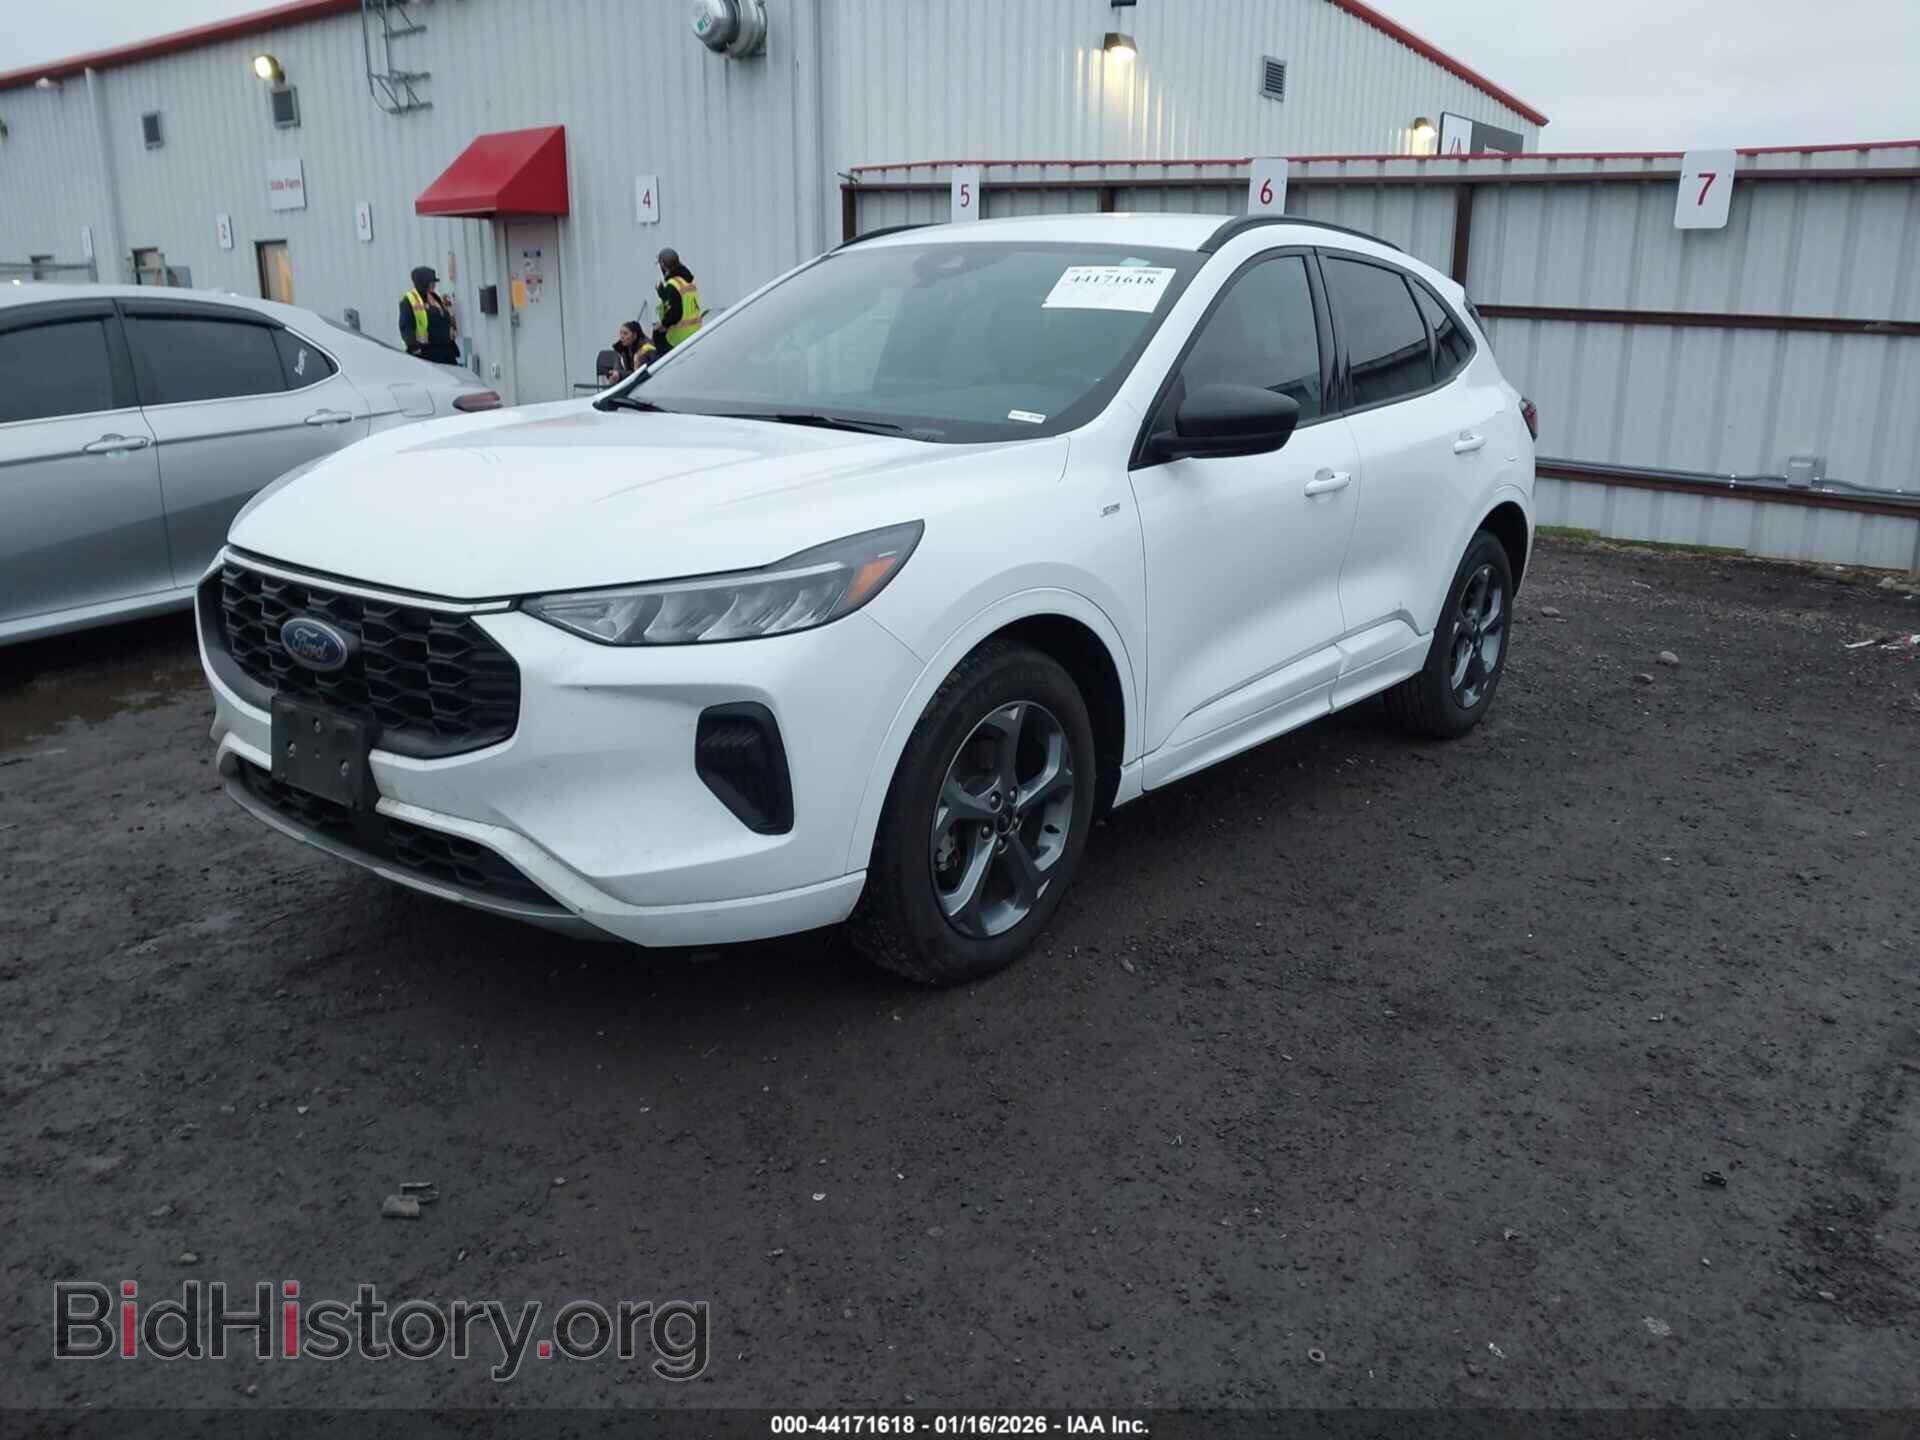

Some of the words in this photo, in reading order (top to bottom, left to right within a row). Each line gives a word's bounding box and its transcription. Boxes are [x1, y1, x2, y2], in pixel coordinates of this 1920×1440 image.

[642, 188, 651, 209] 4
[960, 183, 970, 208] 5
[1260, 177, 1273, 205] 6
[1697, 172, 1717, 206] 7
[220, 222, 228, 240] 2
[1070, 274, 1157, 286] 44171618
[292, 627, 329, 658] Ford
